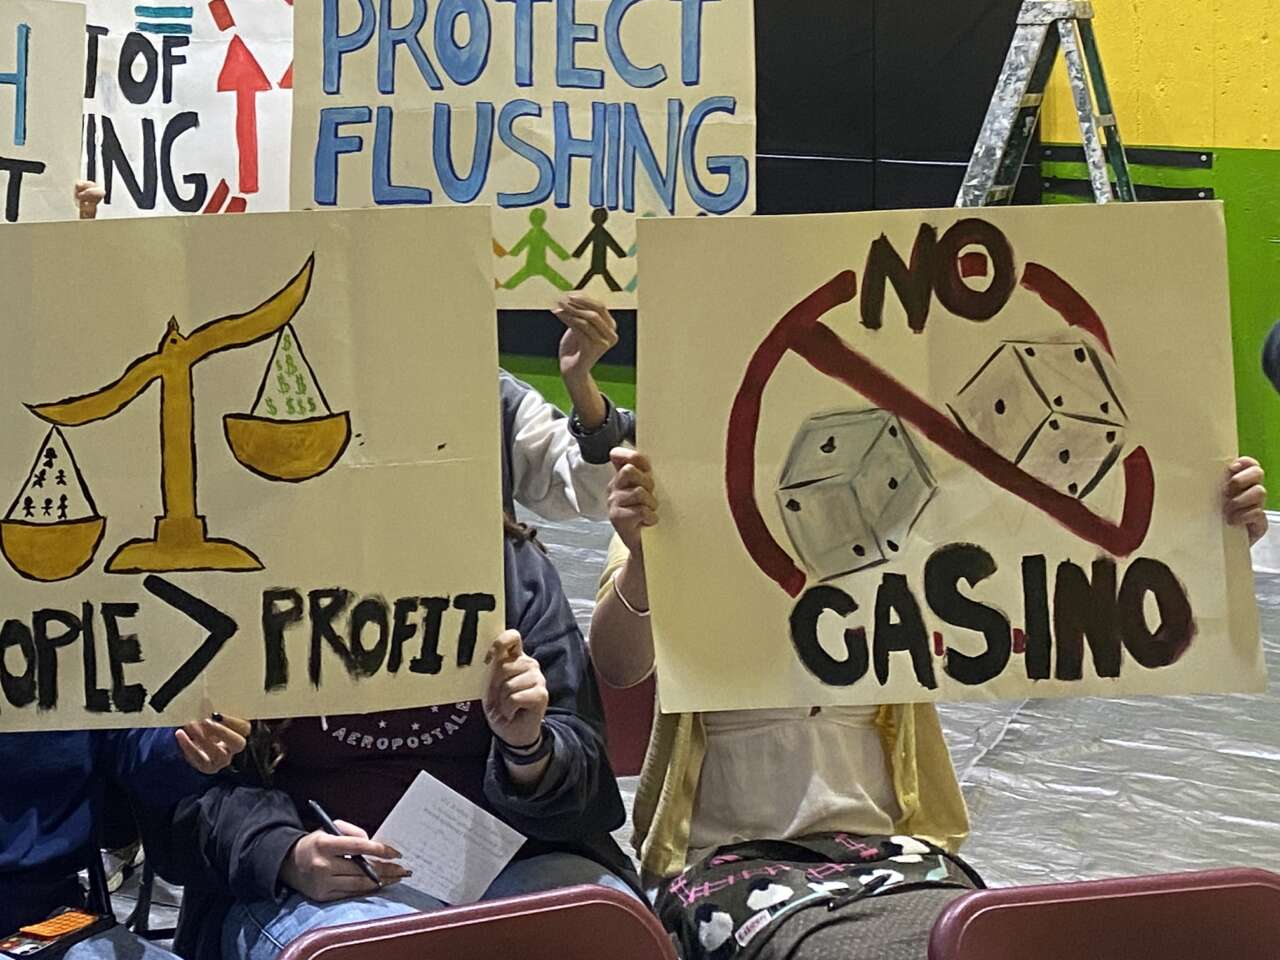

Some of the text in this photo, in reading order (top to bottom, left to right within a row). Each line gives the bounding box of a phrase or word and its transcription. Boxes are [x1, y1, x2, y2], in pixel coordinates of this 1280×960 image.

[118, 31, 189, 104] OF
[314, 96, 749, 216] FLUSHING
[860, 218, 1016, 334] NO
[261, 587, 496, 691] PROFIT
[332, 701, 471, 751] AEROPOSTALE
